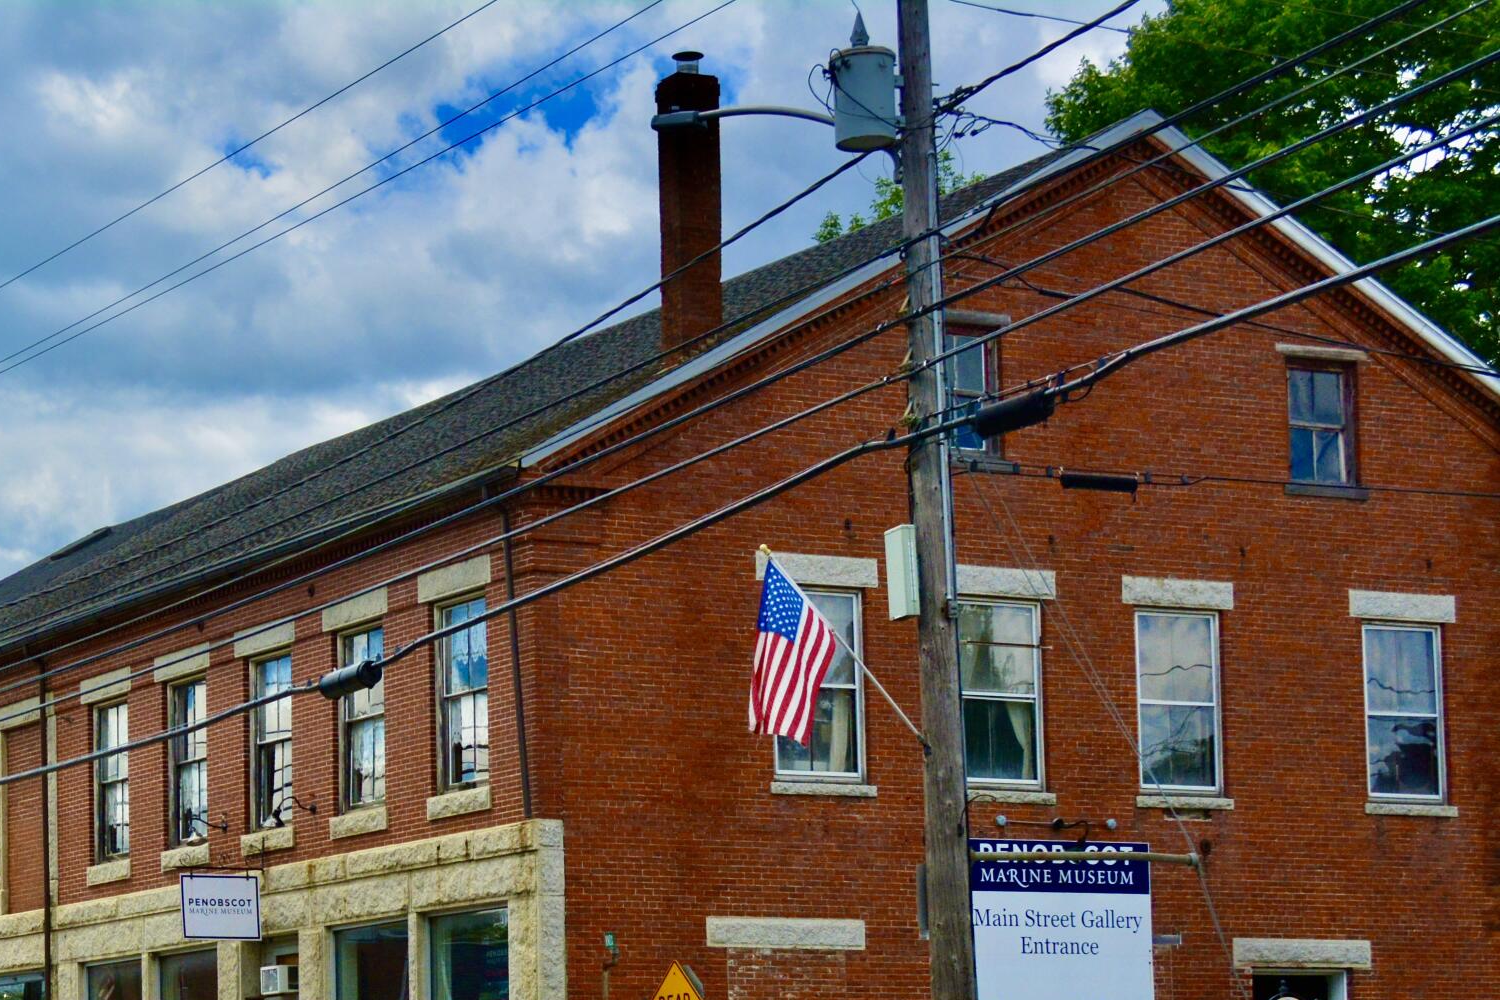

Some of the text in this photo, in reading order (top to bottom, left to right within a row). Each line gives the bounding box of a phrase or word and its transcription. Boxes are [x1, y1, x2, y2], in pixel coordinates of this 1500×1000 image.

[979, 843, 1134, 866] PENOBCOT
[980, 868, 1134, 888] MARINE MUSEUM
[188, 898, 252, 907] PENOBSCOT
[189, 908, 218, 916] MARINE
[973, 908, 1143, 934] Main Street Gallery
[1020, 936, 1100, 955] Entrance
